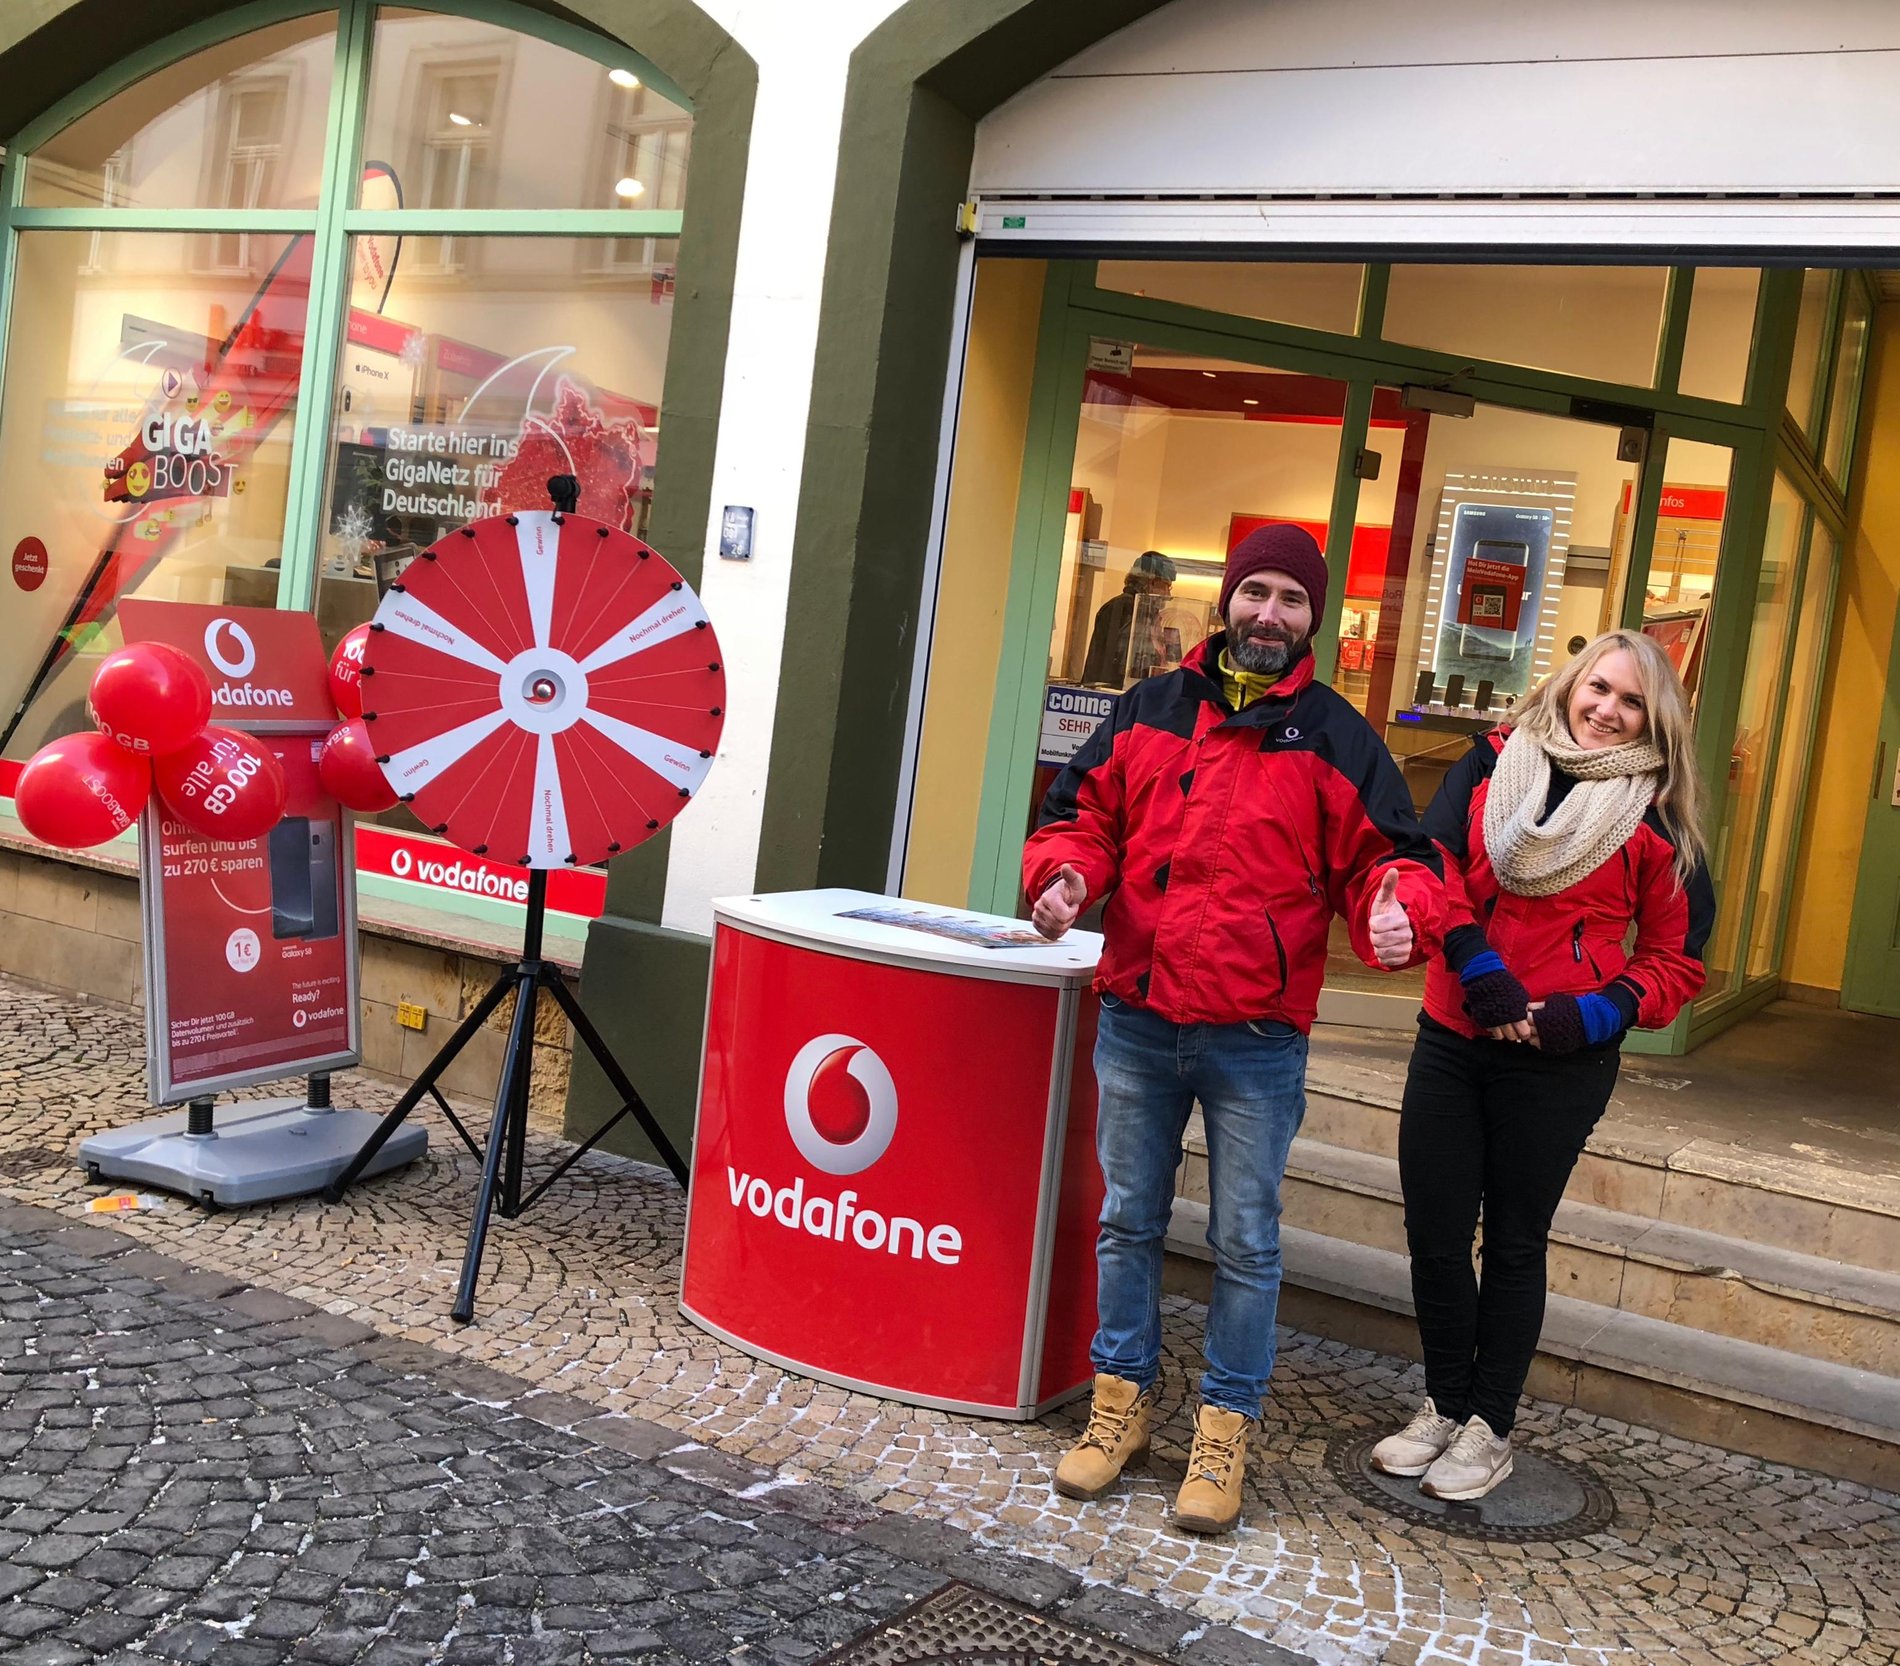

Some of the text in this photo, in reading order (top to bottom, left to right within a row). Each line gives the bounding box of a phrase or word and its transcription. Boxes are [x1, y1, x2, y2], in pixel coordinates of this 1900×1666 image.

[361, 365, 390, 380] iPhone X
[141, 411, 212, 455] GIGA
[388, 427, 519, 458] Starte hier ins
[153, 451, 239, 498] BOOST
[385, 457, 503, 488] GigaNetz für
[382, 488, 502, 519] Deutschland
[1660, 495, 1685, 508] nfos
[23, 552, 38, 563] Jetzt
[14, 564, 45, 575] geschenkt
[394, 608, 456, 646] Nochmal drehen
[628, 605, 687, 644] Nochmal drehen
[335, 660, 356, 683] für
[1049, 692, 1112, 716] conne
[1058, 718, 1091, 734] SEHR
[115, 732, 150, 750] GB
[208, 737, 240, 764] für
[403, 759, 430, 778] Gewinn
[663, 754, 691, 772] Gewinn
[181, 760, 214, 797] alle
[203, 752, 261, 815] 100 GB
[81, 775, 131, 828] GIGABOOST
[544, 789, 552, 823] Nochmal
[163, 840, 207, 857] surfen
[164, 857, 264, 877] zu 270 € sparen
[417, 860, 529, 900] vodafone
[281, 948, 304, 959] Galaxy
[292, 989, 320, 1004] Ready?
[170, 1010, 235, 1029] Sicher Dir jetzt 100 GB
[216, 1022, 228, 1031] und
[228, 1016, 255, 1028] zusätzlich
[308, 1007, 344, 1020] vodafone
[171, 1038, 181, 1047] bis
[189, 1035, 202, 1044] 270
[727, 1165, 963, 1265] vodafone
